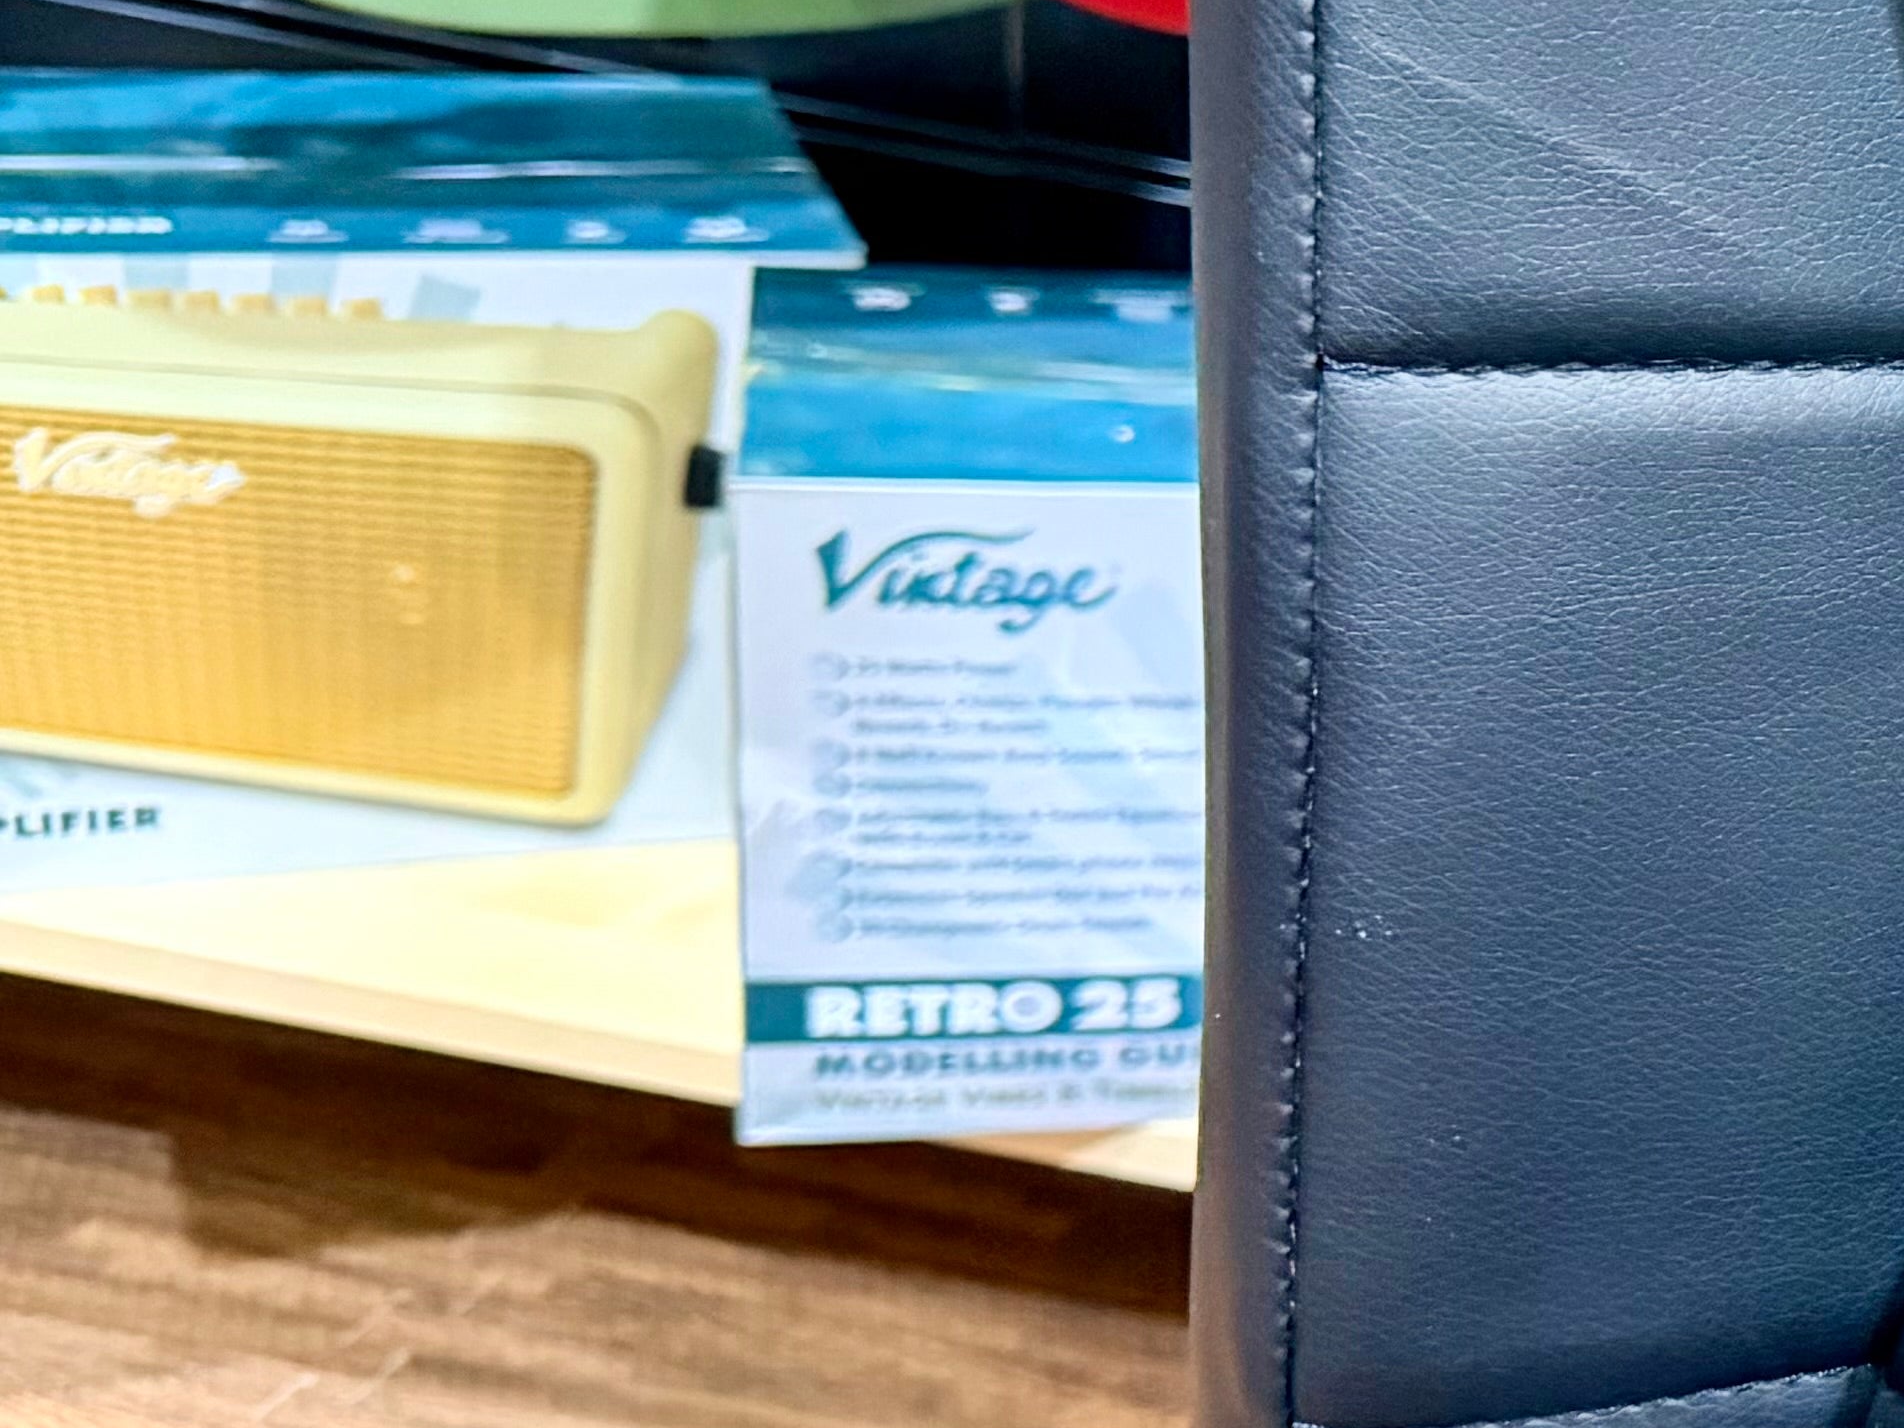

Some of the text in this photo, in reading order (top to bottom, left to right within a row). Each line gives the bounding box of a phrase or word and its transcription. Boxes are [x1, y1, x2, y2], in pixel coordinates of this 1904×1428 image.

[816, 529, 1117, 633] Vintage
[806, 978, 1182, 1039] RETRO 25
[815, 1046, 1100, 1081] MODELLING
